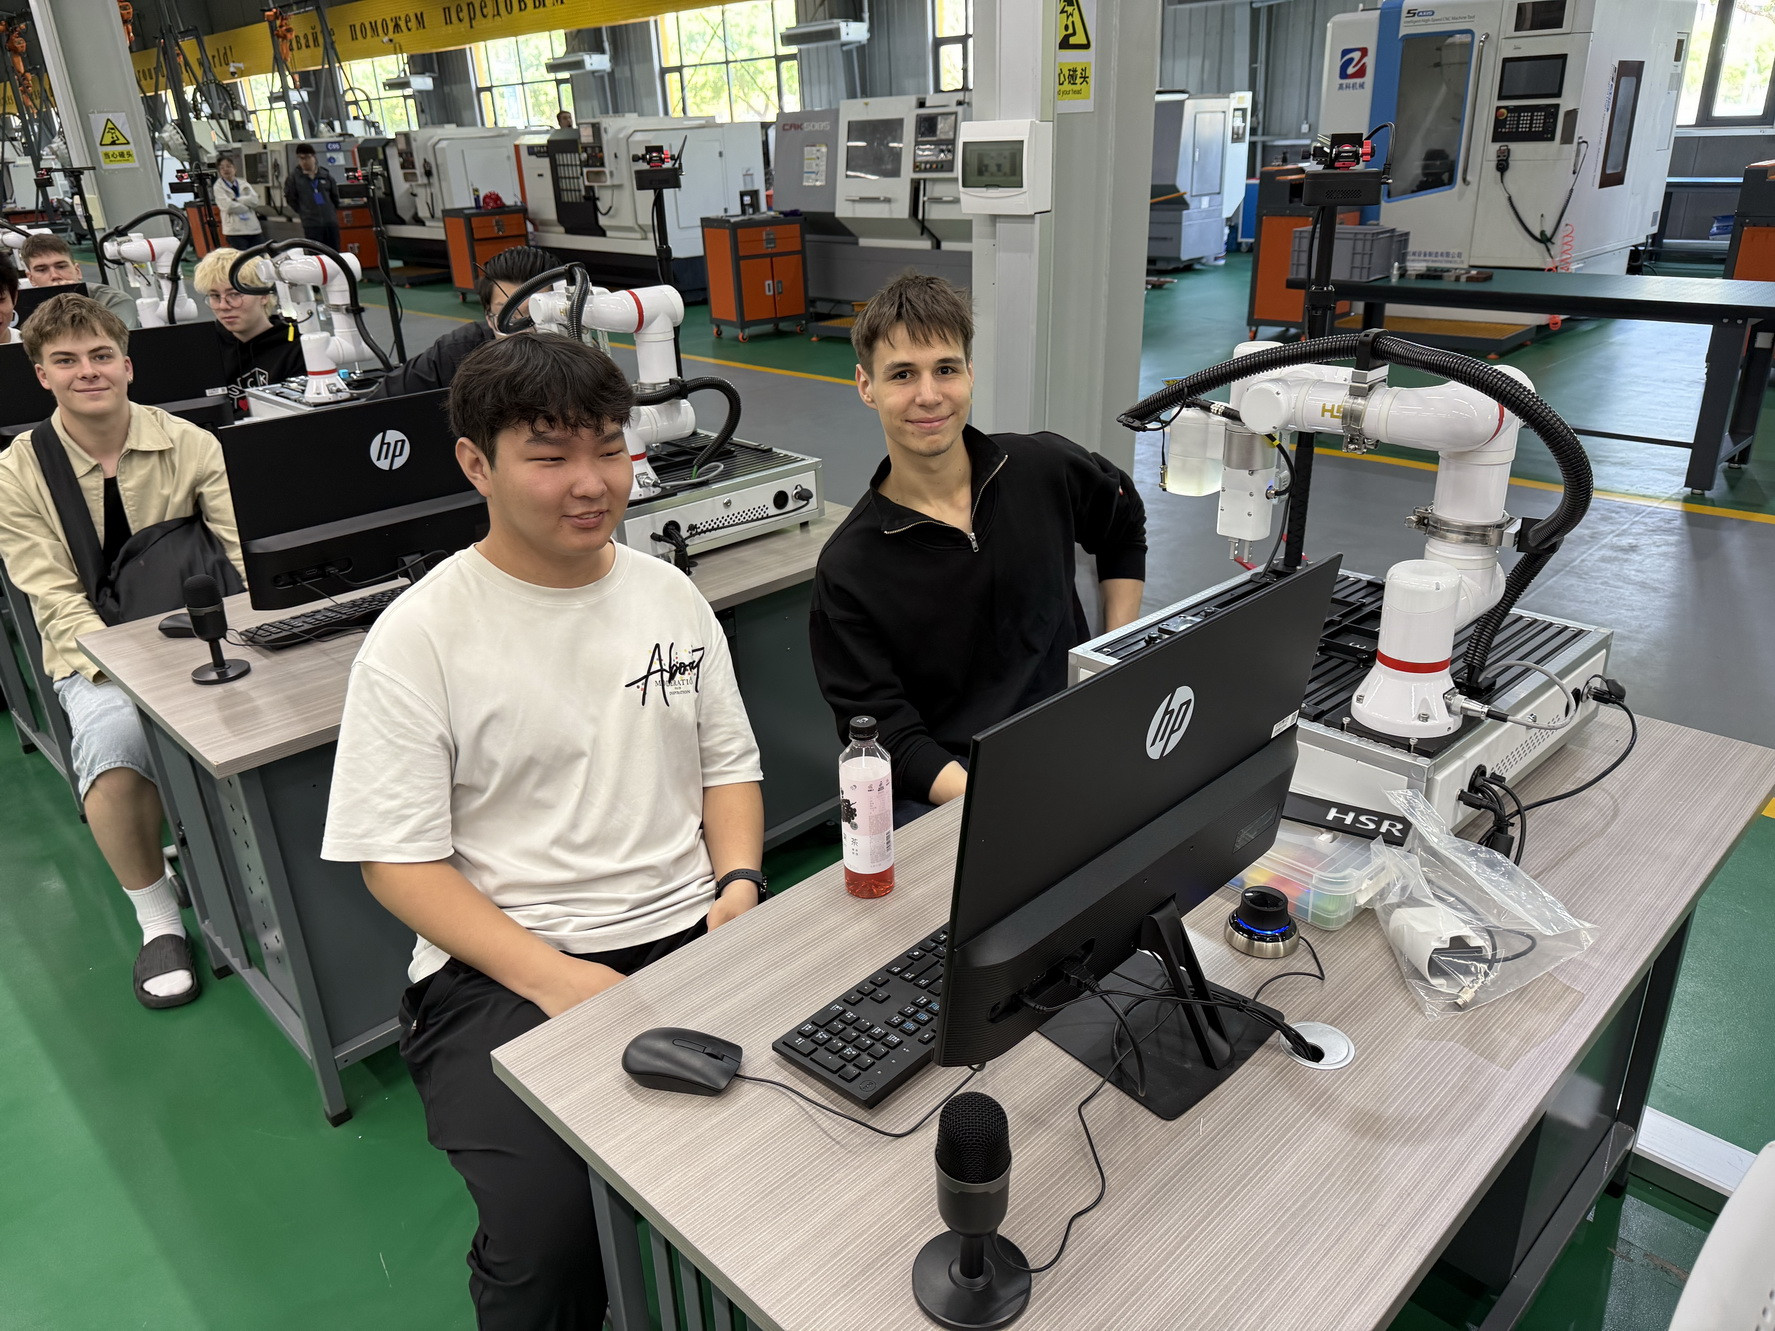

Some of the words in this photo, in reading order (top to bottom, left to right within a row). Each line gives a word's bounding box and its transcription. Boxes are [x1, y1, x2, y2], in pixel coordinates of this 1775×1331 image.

[350, 11, 426, 41] поможем
[373, 430, 408, 470] hp
[1148, 688, 1194, 759] hp
[1326, 807, 1404, 837] HSR
